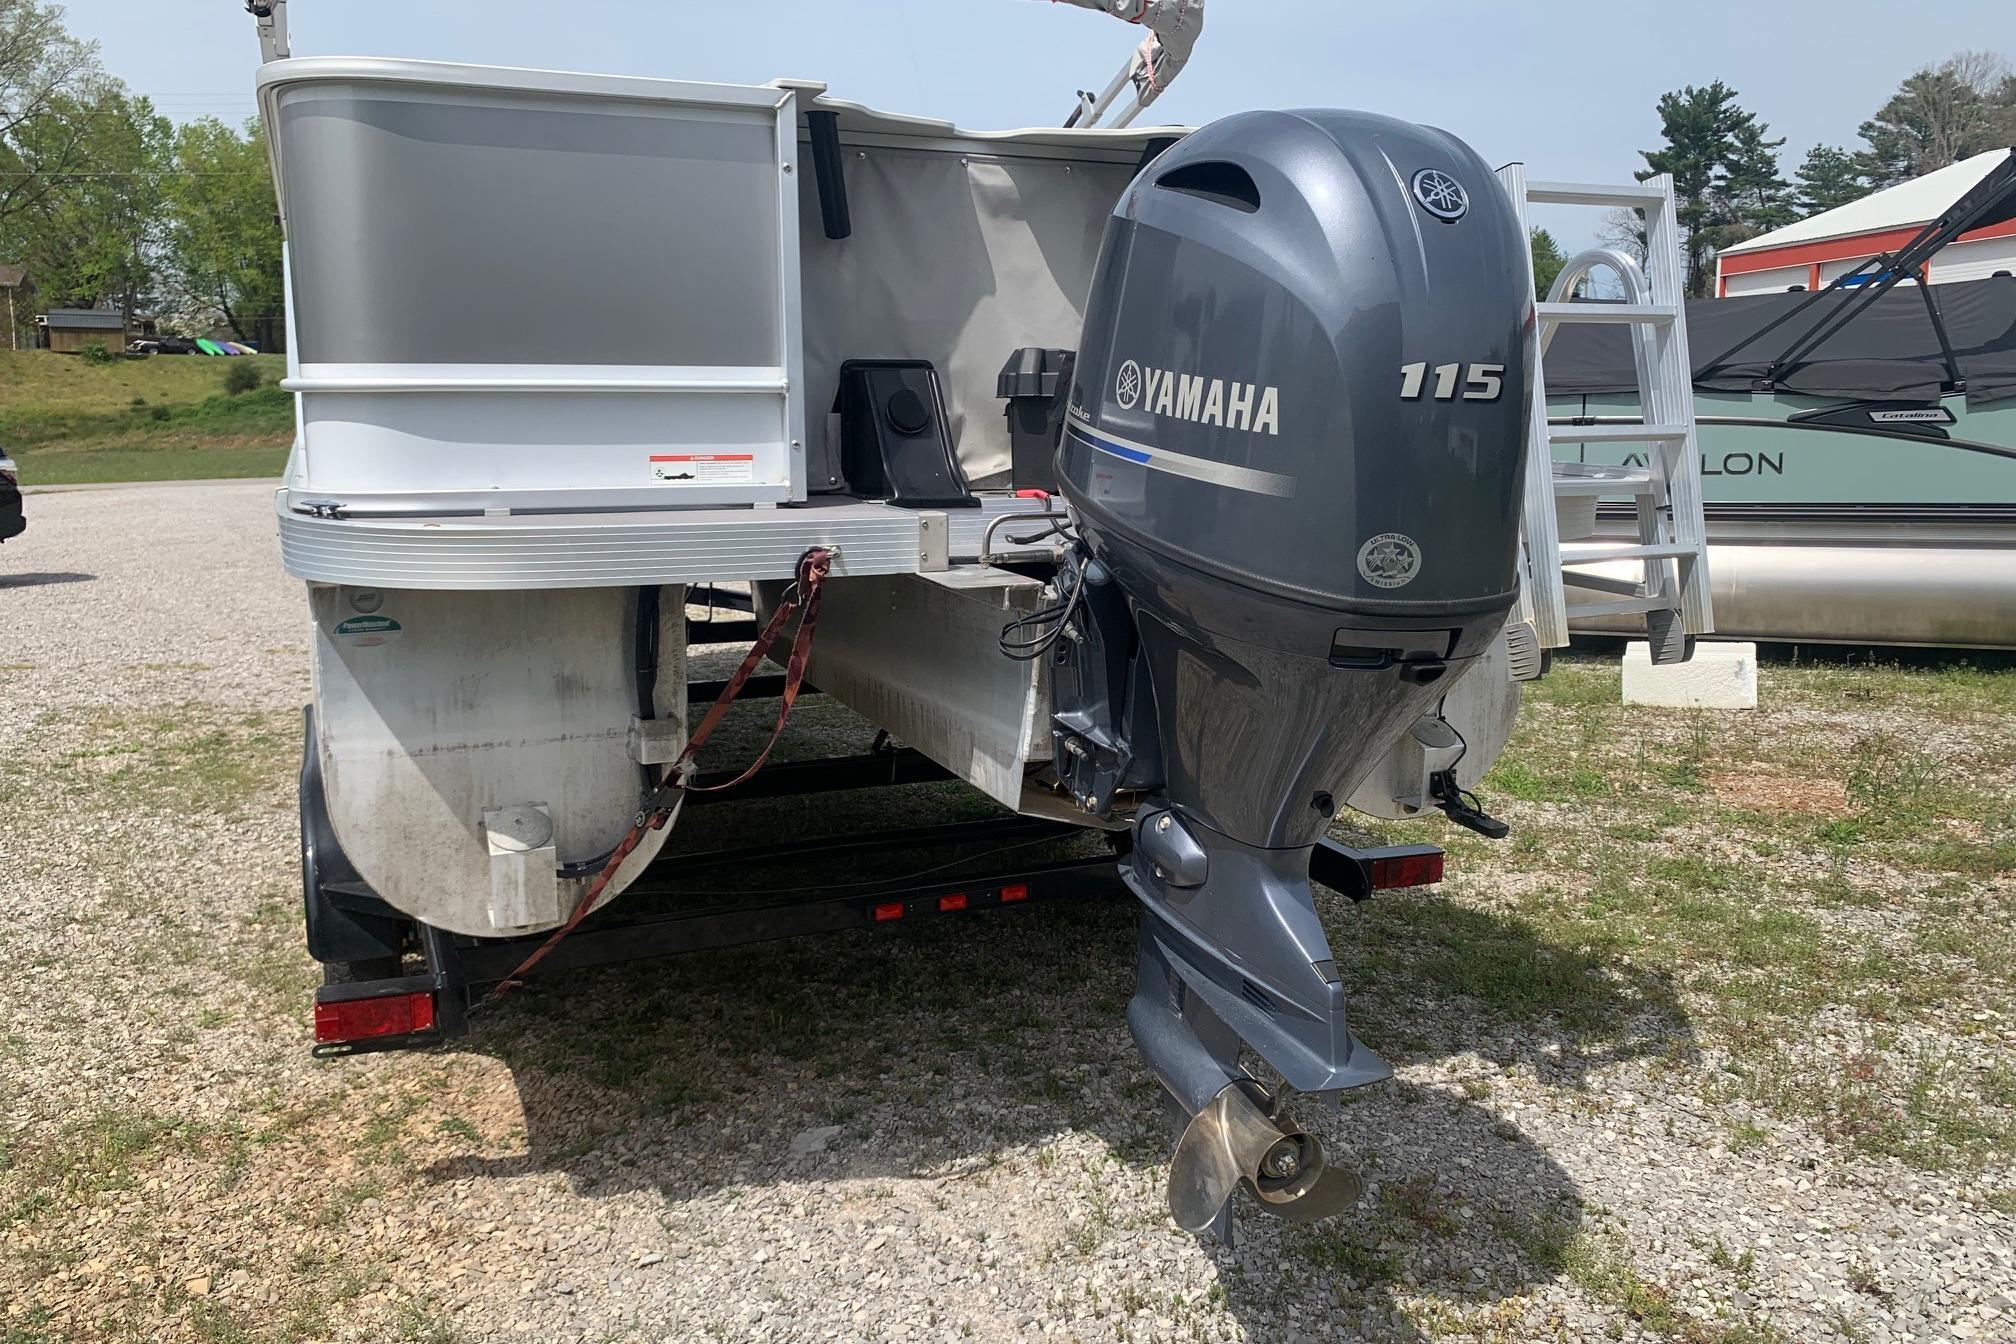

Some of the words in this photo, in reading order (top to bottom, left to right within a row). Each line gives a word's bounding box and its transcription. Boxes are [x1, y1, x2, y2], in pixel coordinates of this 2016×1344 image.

[1400, 362, 1504, 399] 115
[1144, 367, 1279, 436] YAMAHA
[1622, 452, 1784, 476] ALON
